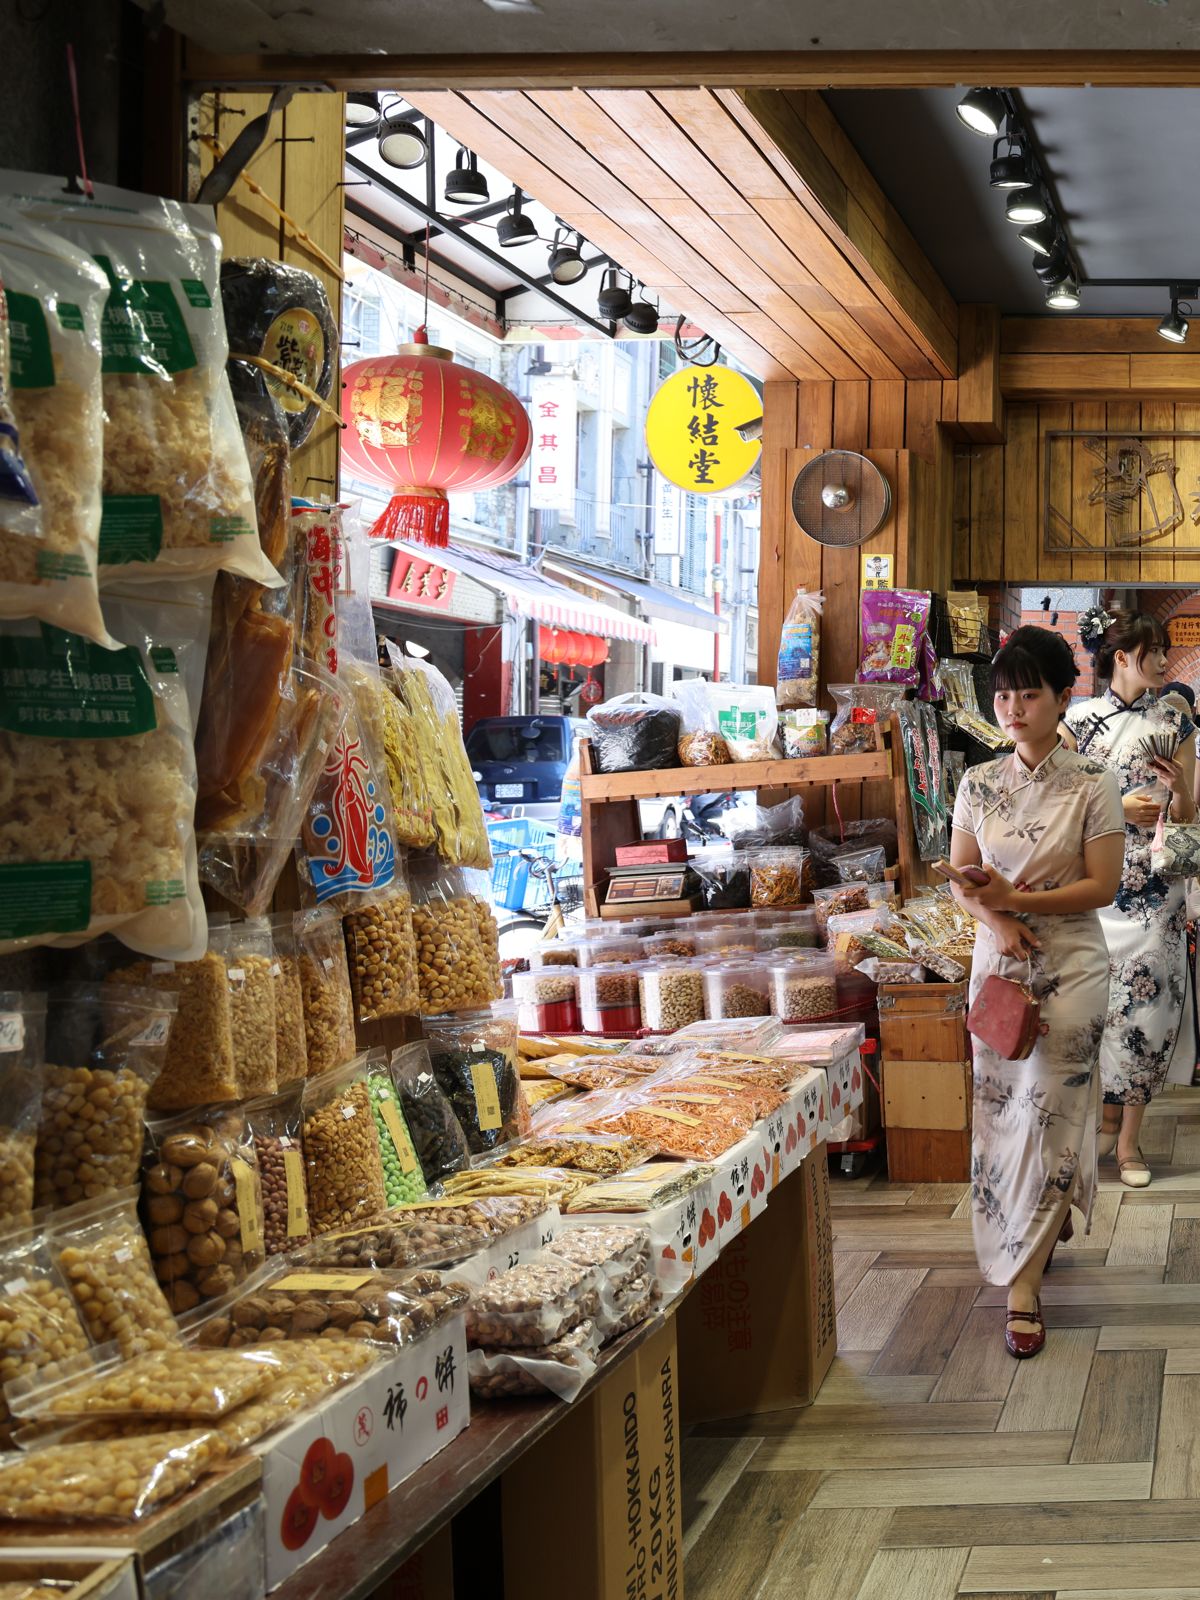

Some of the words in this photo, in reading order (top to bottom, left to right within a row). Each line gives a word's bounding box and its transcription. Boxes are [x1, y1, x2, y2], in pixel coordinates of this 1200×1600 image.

[537, 400, 559, 485] 全其昌
[686, 373, 725, 485] 懷結堂
[648, 1465, 662, 1585] 20KG
